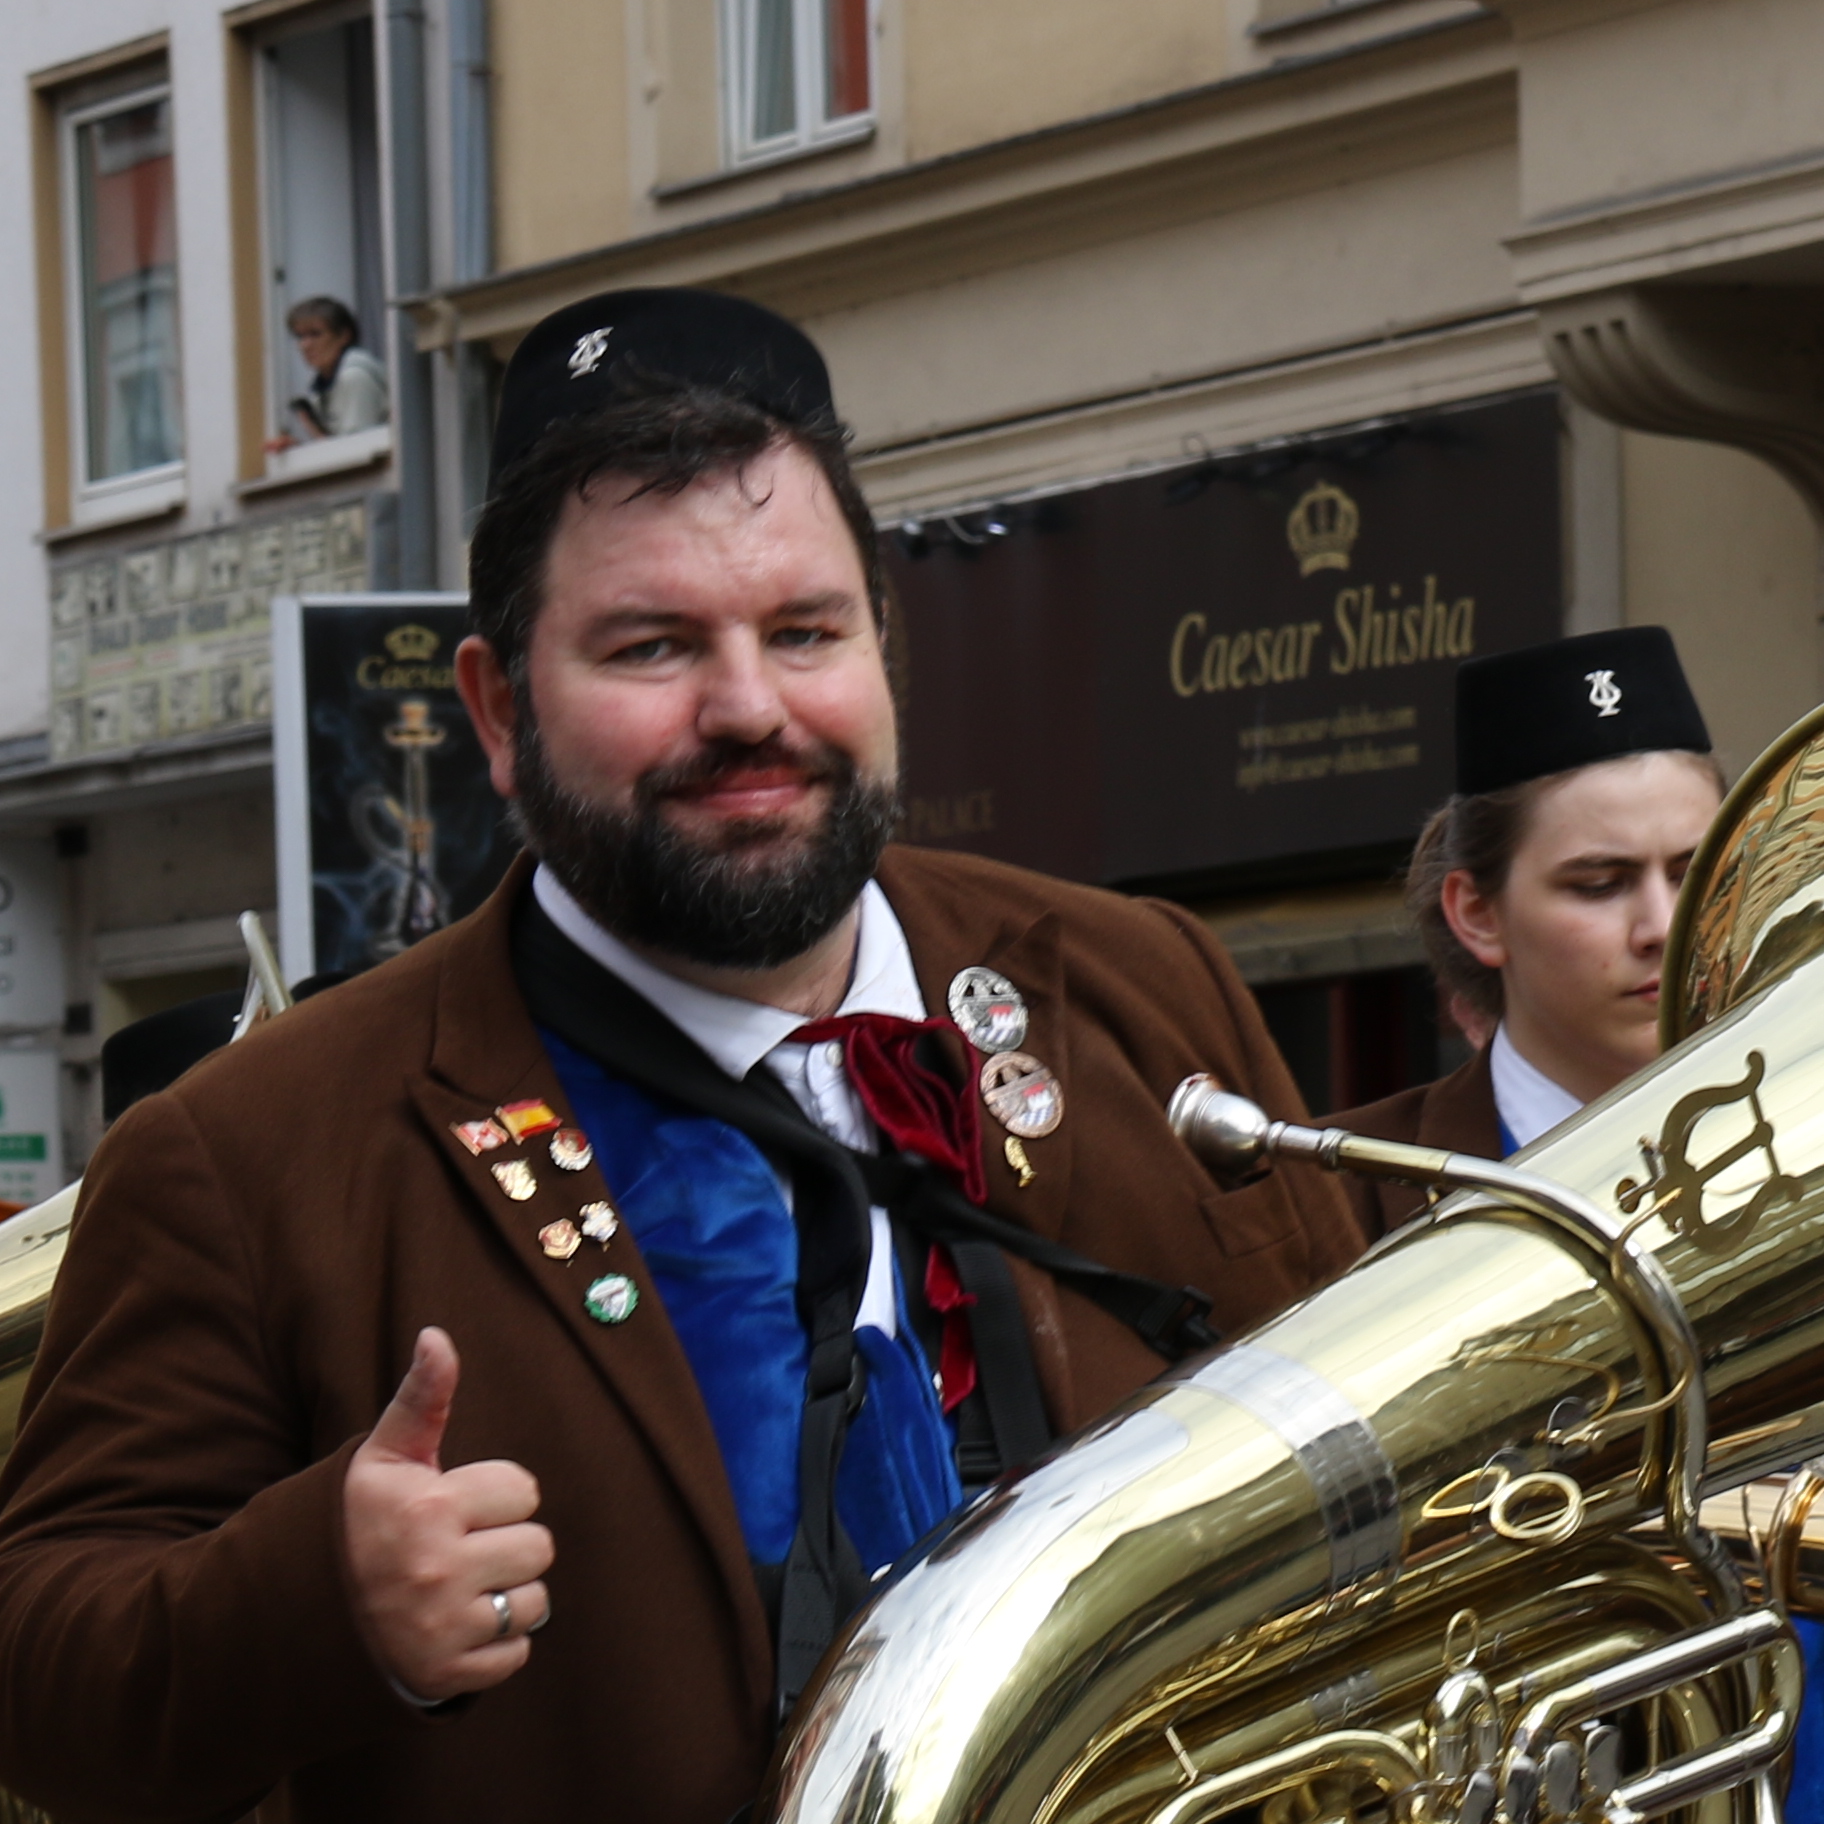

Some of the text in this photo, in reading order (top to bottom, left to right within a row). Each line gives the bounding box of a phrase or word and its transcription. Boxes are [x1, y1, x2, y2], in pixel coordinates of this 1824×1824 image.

[356, 655, 458, 691] Caesa
[1169, 573, 1475, 697] Caesar Shisha
